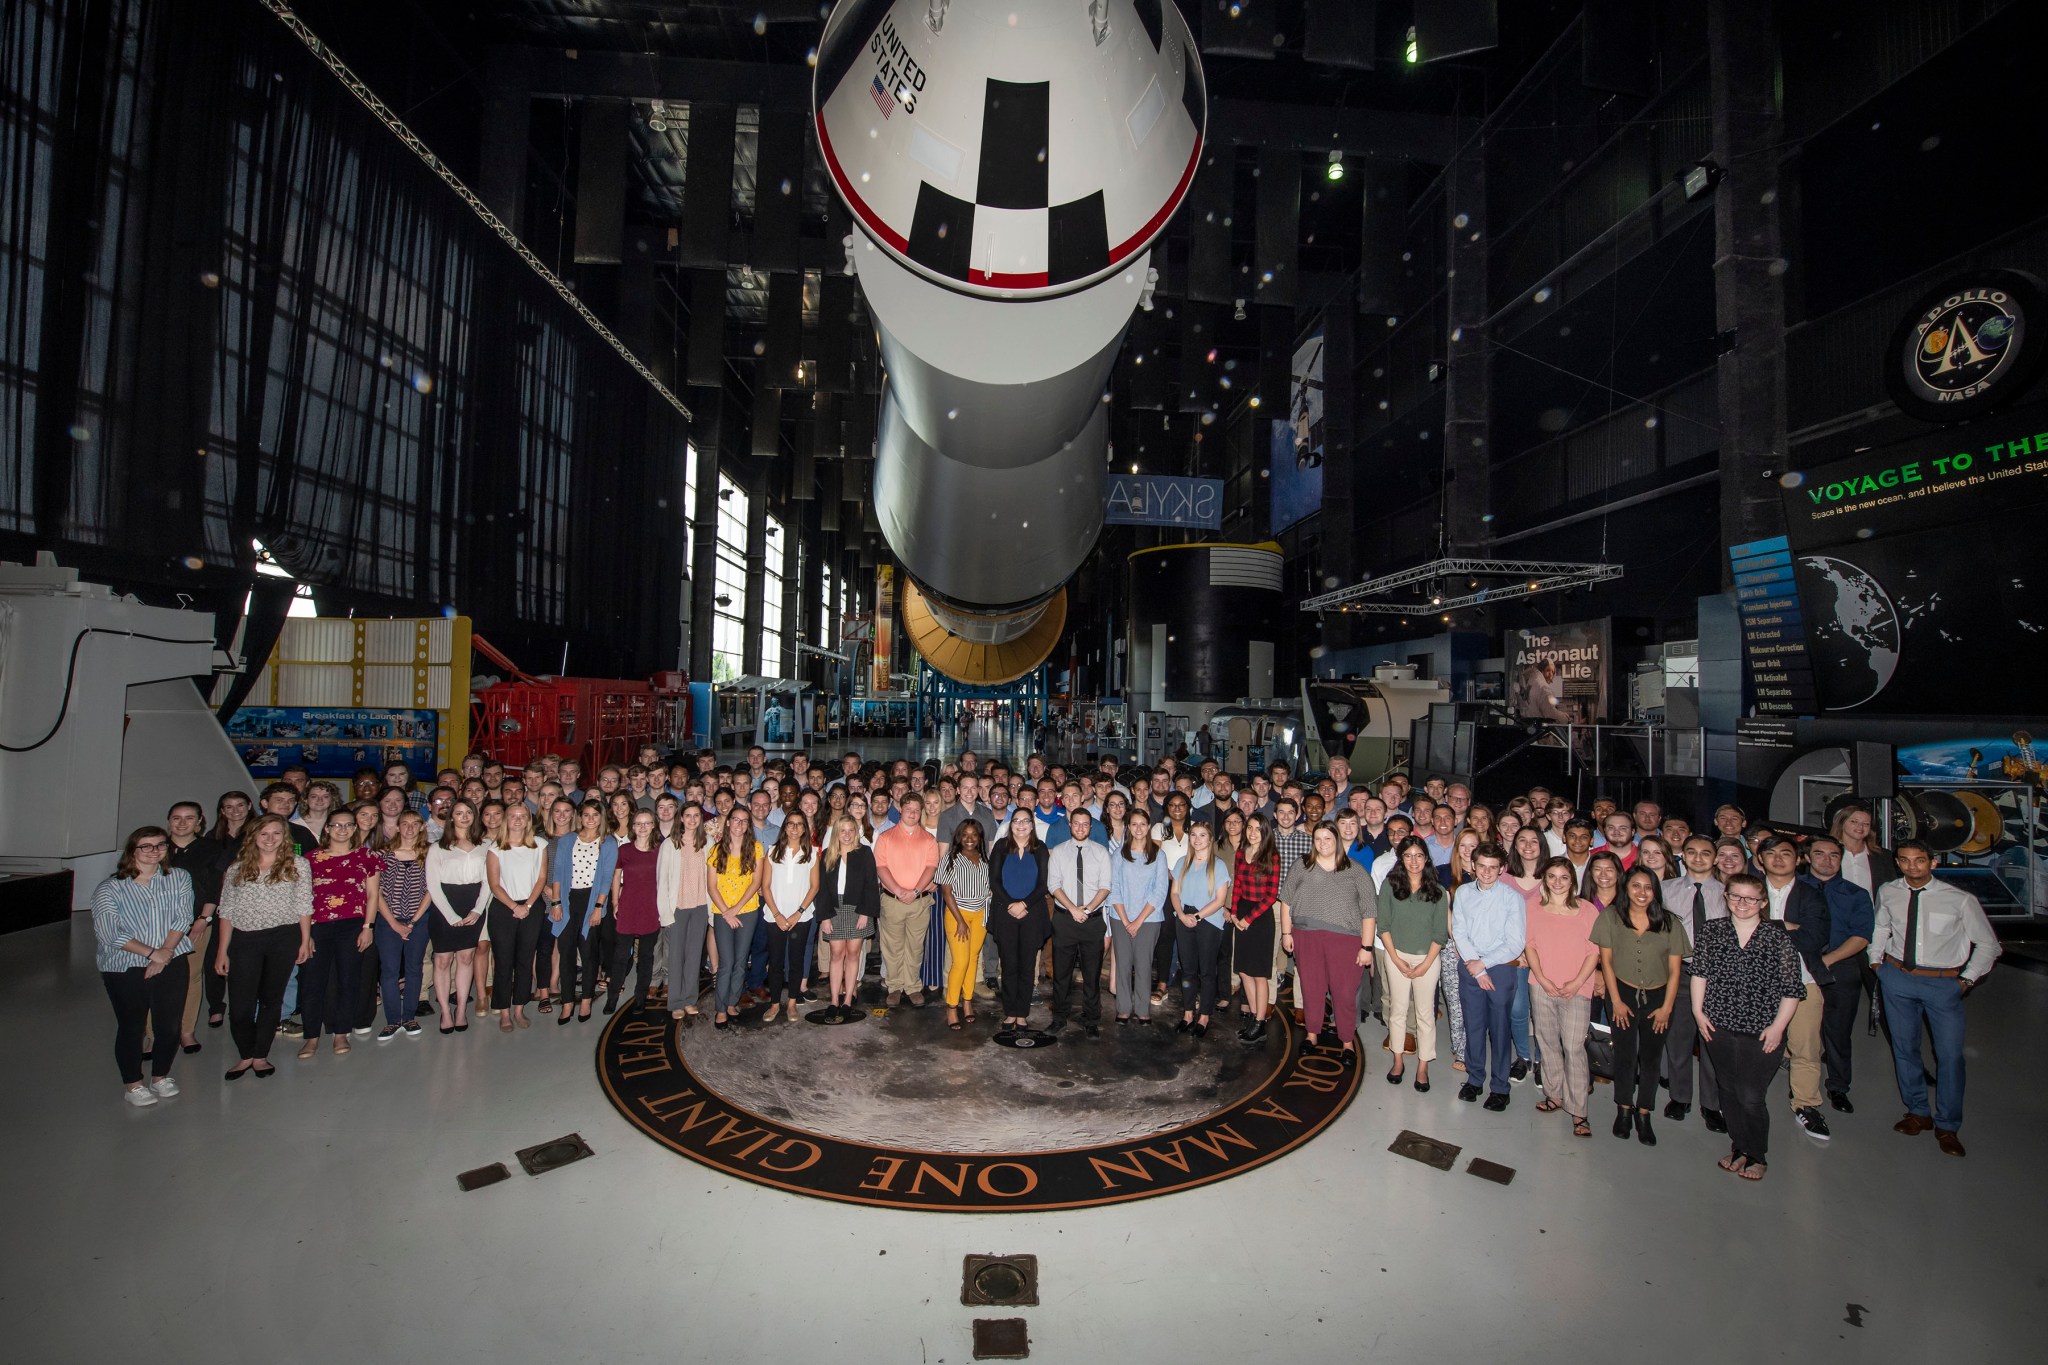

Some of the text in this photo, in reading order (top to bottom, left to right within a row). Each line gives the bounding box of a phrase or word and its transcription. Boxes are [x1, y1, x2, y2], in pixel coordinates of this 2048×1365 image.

[882, 14, 926, 92] UNITED
[871, 33, 917, 114] STATES
[1917, 289, 2007, 336] APOLLO
[1938, 381, 1991, 402] NASA
[1807, 432, 2048, 505] VOYAGE TO THE
[1811, 508, 1834, 520] Space
[1836, 507, 1843, 515] is
[1844, 504, 1857, 513] the
[1858, 499, 1876, 510] new
[1908, 487, 1925, 499] and
[1927, 486, 1931, 495] I
[1932, 479, 1967, 494] believe
[1968, 475, 1985, 486] the
[1987, 465, 2022, 481] United
[2024, 460, 2048, 473] Stat
[1523, 635, 1550, 648] The
[1776, 643, 1804, 652] Correction
[1516, 644, 1599, 665] Astronaut
[1561, 663, 1592, 679] Life
[1766, 688, 1792, 697] Separates
[302, 711, 402, 720] Breakfast to Launch
[1768, 702, 1793, 710] Descends
[617, 1021, 1345, 1197] FOR A MAN ONE GIANT LEAP
